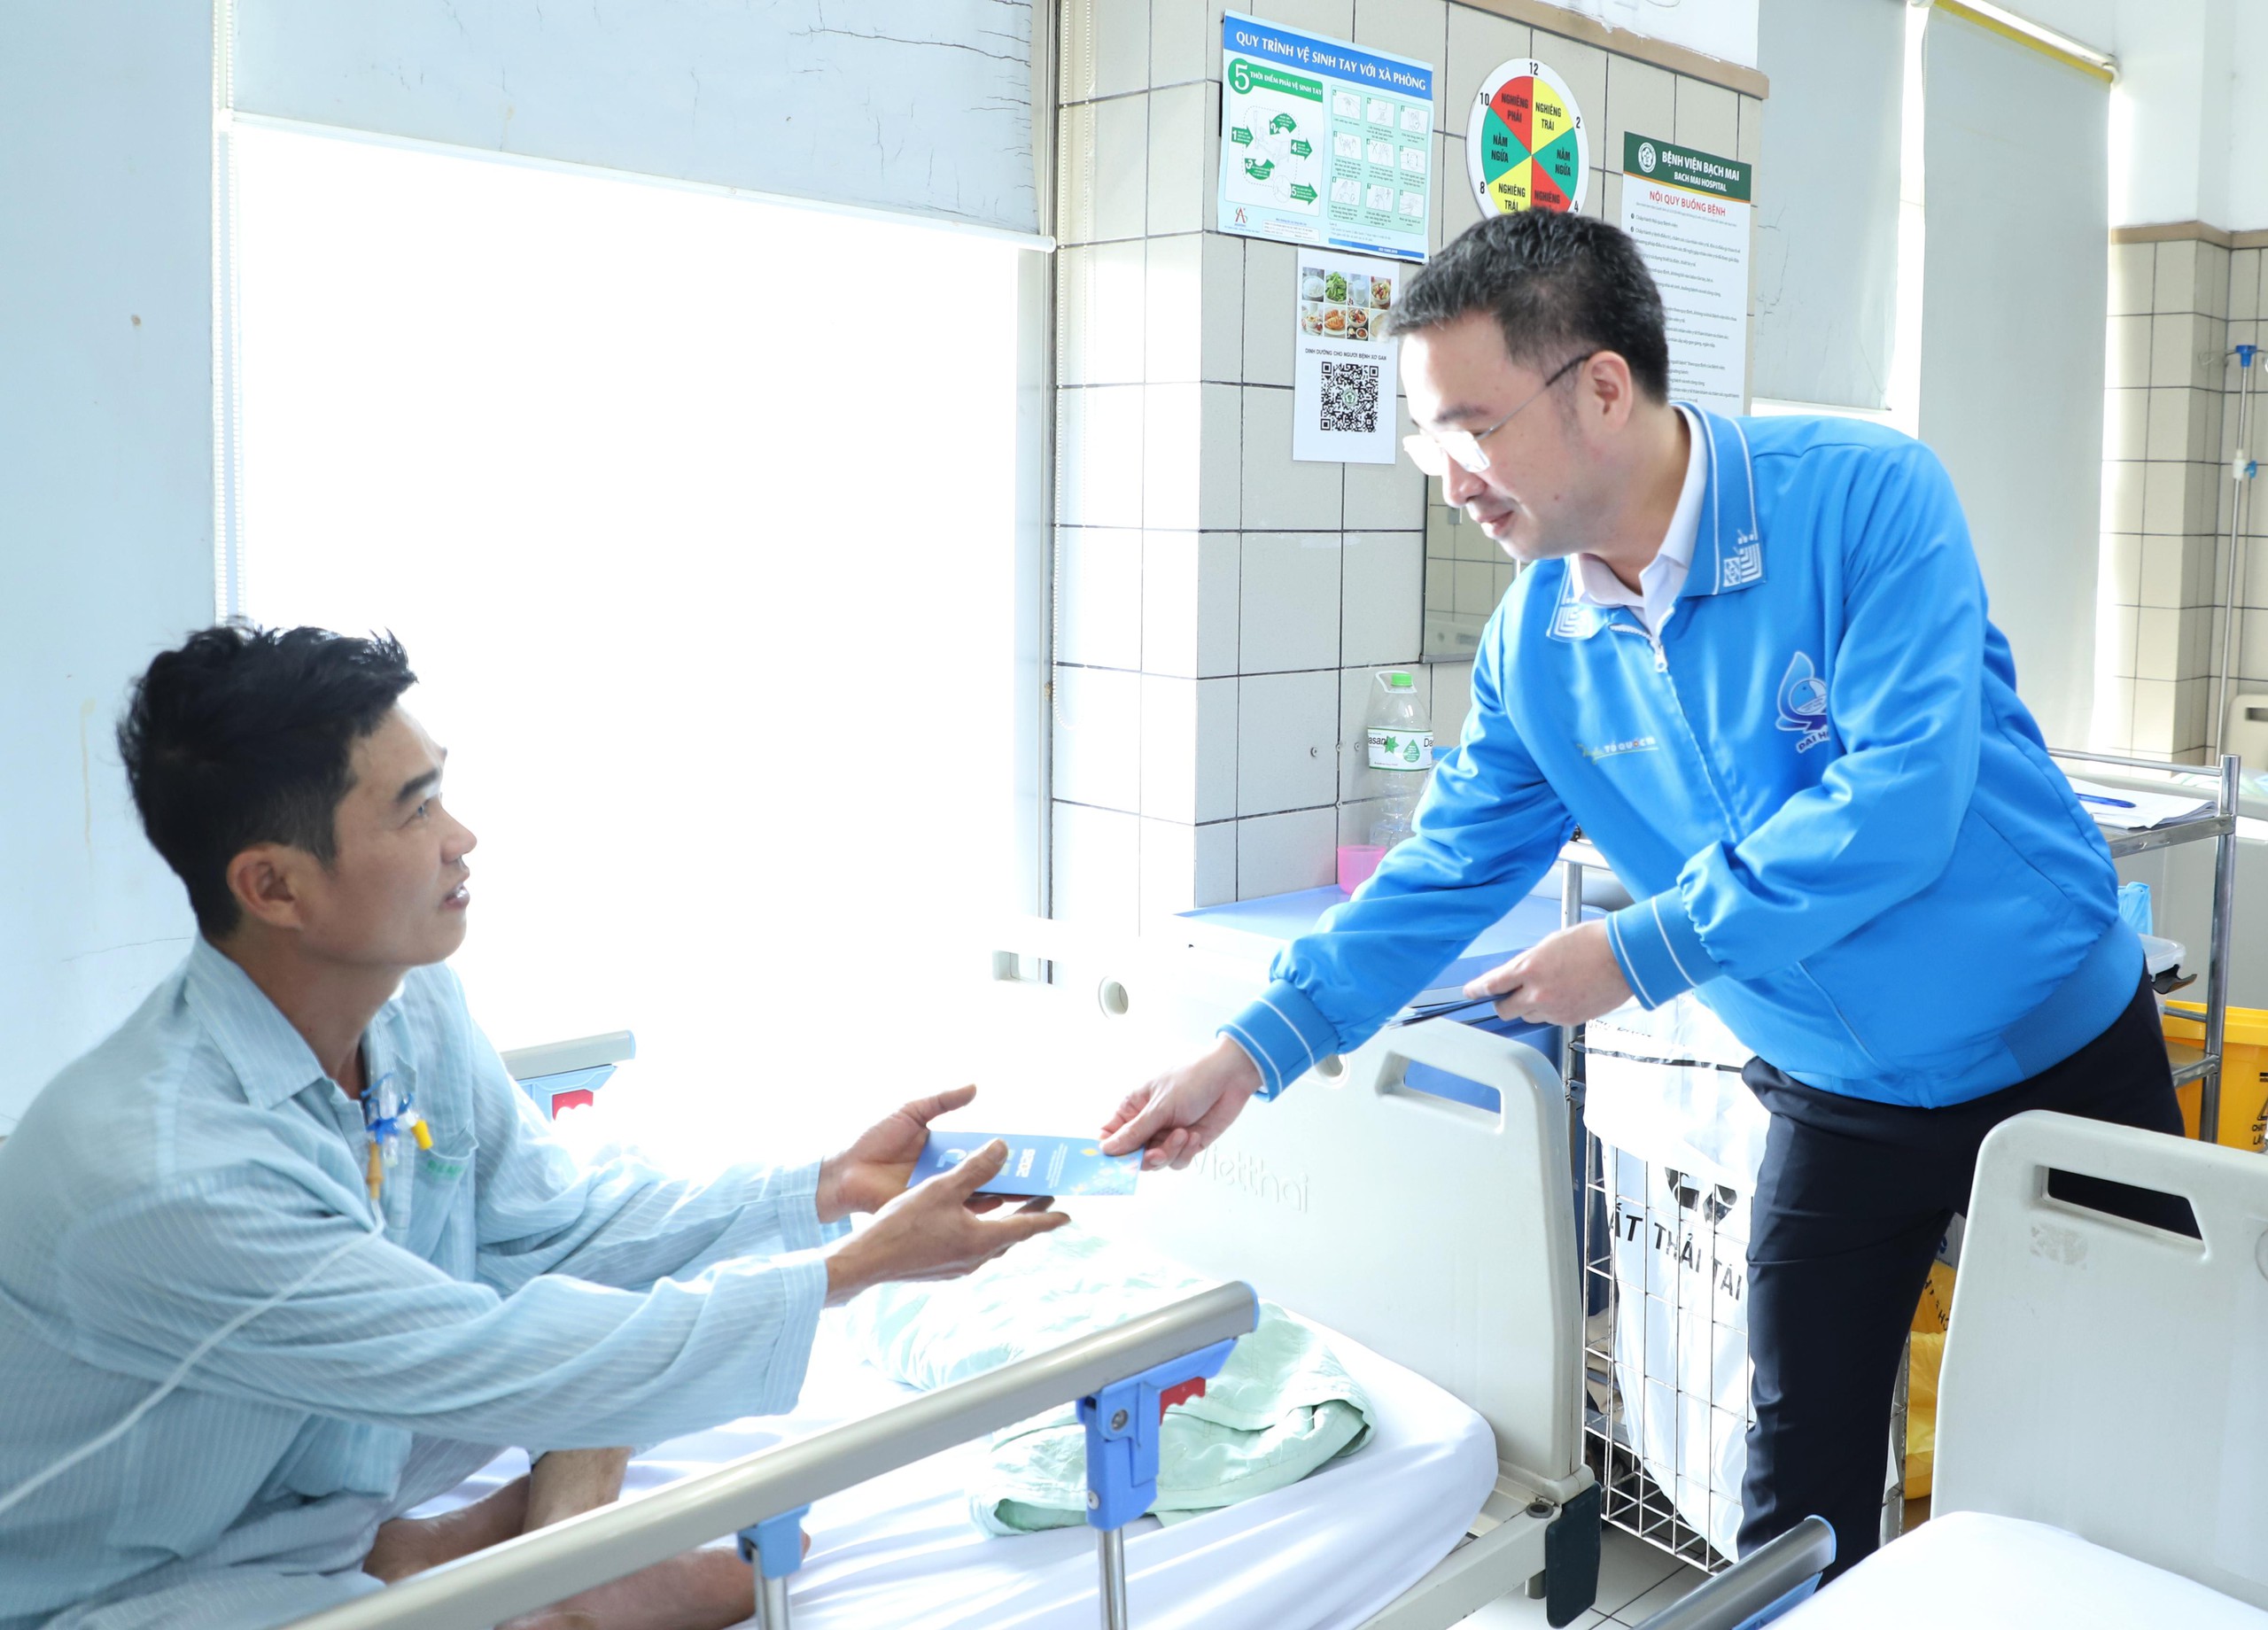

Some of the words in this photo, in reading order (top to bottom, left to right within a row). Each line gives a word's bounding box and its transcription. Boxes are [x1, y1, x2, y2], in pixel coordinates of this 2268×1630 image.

[1236, 31, 1259, 47] QUY
[1262, 37, 1293, 57] TRÌNH
[1296, 46, 1309, 63] VỆ
[1311, 51, 1336, 67] SINH
[1339, 58, 1357, 73] TAY
[1360, 63, 1376, 77] VỚI
[1379, 67, 1391, 82] XÀ
[1394, 73, 1425, 90] PHÒNG
[1529, 62, 1539, 75] 12
[1234, 63, 1250, 90] 5
[1299, 84, 1311, 93] SINH
[1312, 87, 1322, 96] TAY
[1480, 92, 1490, 106] 10
[1501, 92, 1529, 108] NGHIÊNG
[1535, 102, 1562, 117] NGHIÊNG
[1507, 111, 1522, 123] PHẢI
[1575, 116, 1581, 128] 2
[1541, 119, 1554, 131] TRÁI
[1232, 129, 1238, 140] 1
[1493, 134, 1508, 148] NẰM
[1291, 142, 1298, 152] 4
[1491, 150, 1509, 163] NGỬA
[1557, 148, 1571, 161] NẰM
[1246, 159, 1254, 169] 3
[1555, 164, 1571, 177] NGỬA
[1662, 150, 1683, 167] BỆNH
[1684, 157, 1702, 173] VIỆN
[1703, 161, 1724, 177] BẠCH
[1725, 167, 1740, 182] MAI
[1480, 182, 1485, 194] 8
[1674, 172, 1689, 182] BACH
[1689, 175, 1701, 185] MAI
[1701, 178, 1727, 192] HOSPITAL
[1498, 182, 1526, 198] NGHIÊNG
[1534, 189, 1560, 204] NGHIÊNG
[1574, 200, 1580, 213] 4
[1650, 190, 1663, 204] NỘI
[1664, 194, 1680, 206] QUY
[1707, 203, 1726, 217] BỆNH
